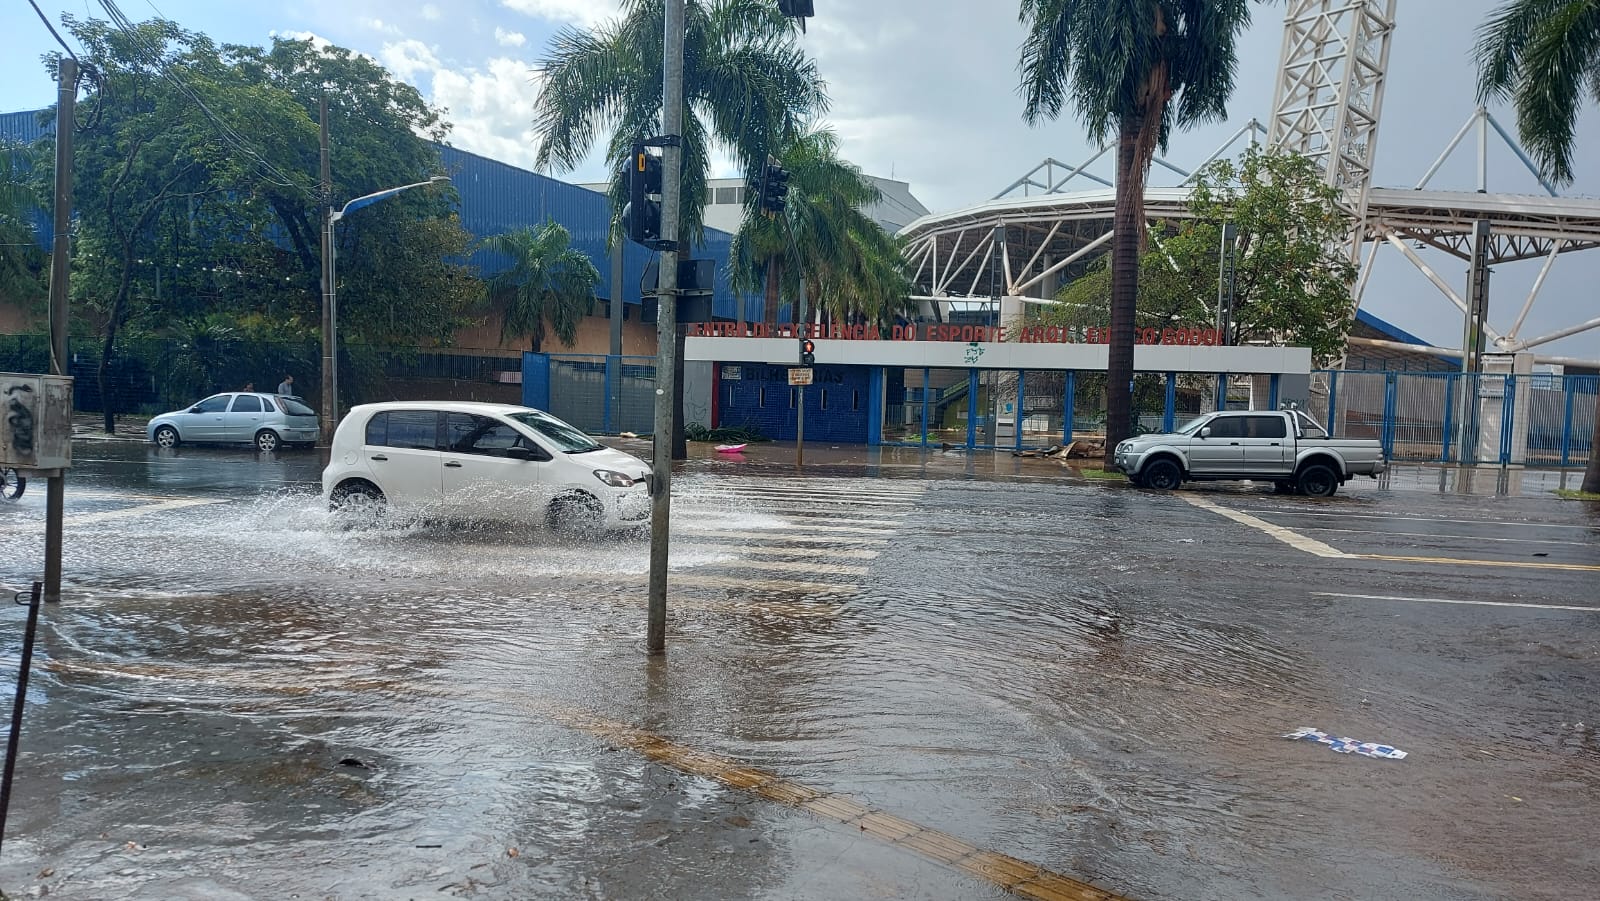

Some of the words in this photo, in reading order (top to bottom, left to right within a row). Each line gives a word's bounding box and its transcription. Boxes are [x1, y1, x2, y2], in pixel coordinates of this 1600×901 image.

[892, 324, 917, 341] DO
[926, 325, 1007, 343] ESPORTE
[1162, 327, 1223, 346] GODOI
